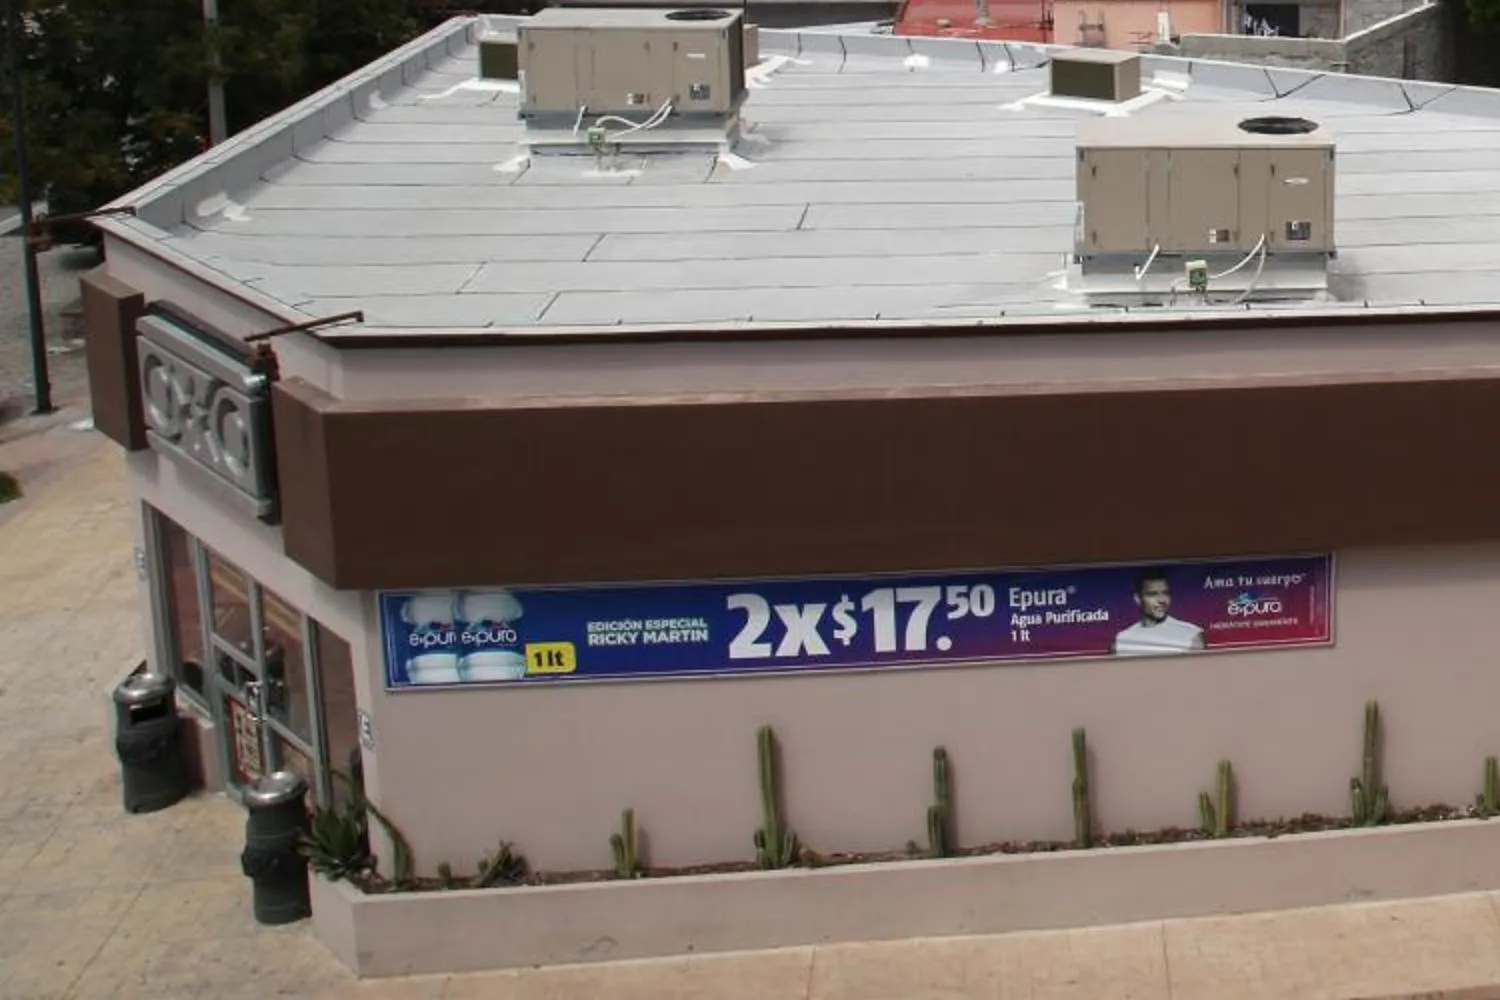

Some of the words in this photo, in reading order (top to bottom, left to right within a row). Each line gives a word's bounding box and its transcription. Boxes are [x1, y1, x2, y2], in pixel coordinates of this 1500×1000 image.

[645, 617, 708, 631] ESPECIAL
[1010, 612, 1042, 629] Agua
[1045, 608, 1109, 625] Purificada
[587, 631, 638, 647] RICKY
[642, 629, 709, 644] MARTIN
